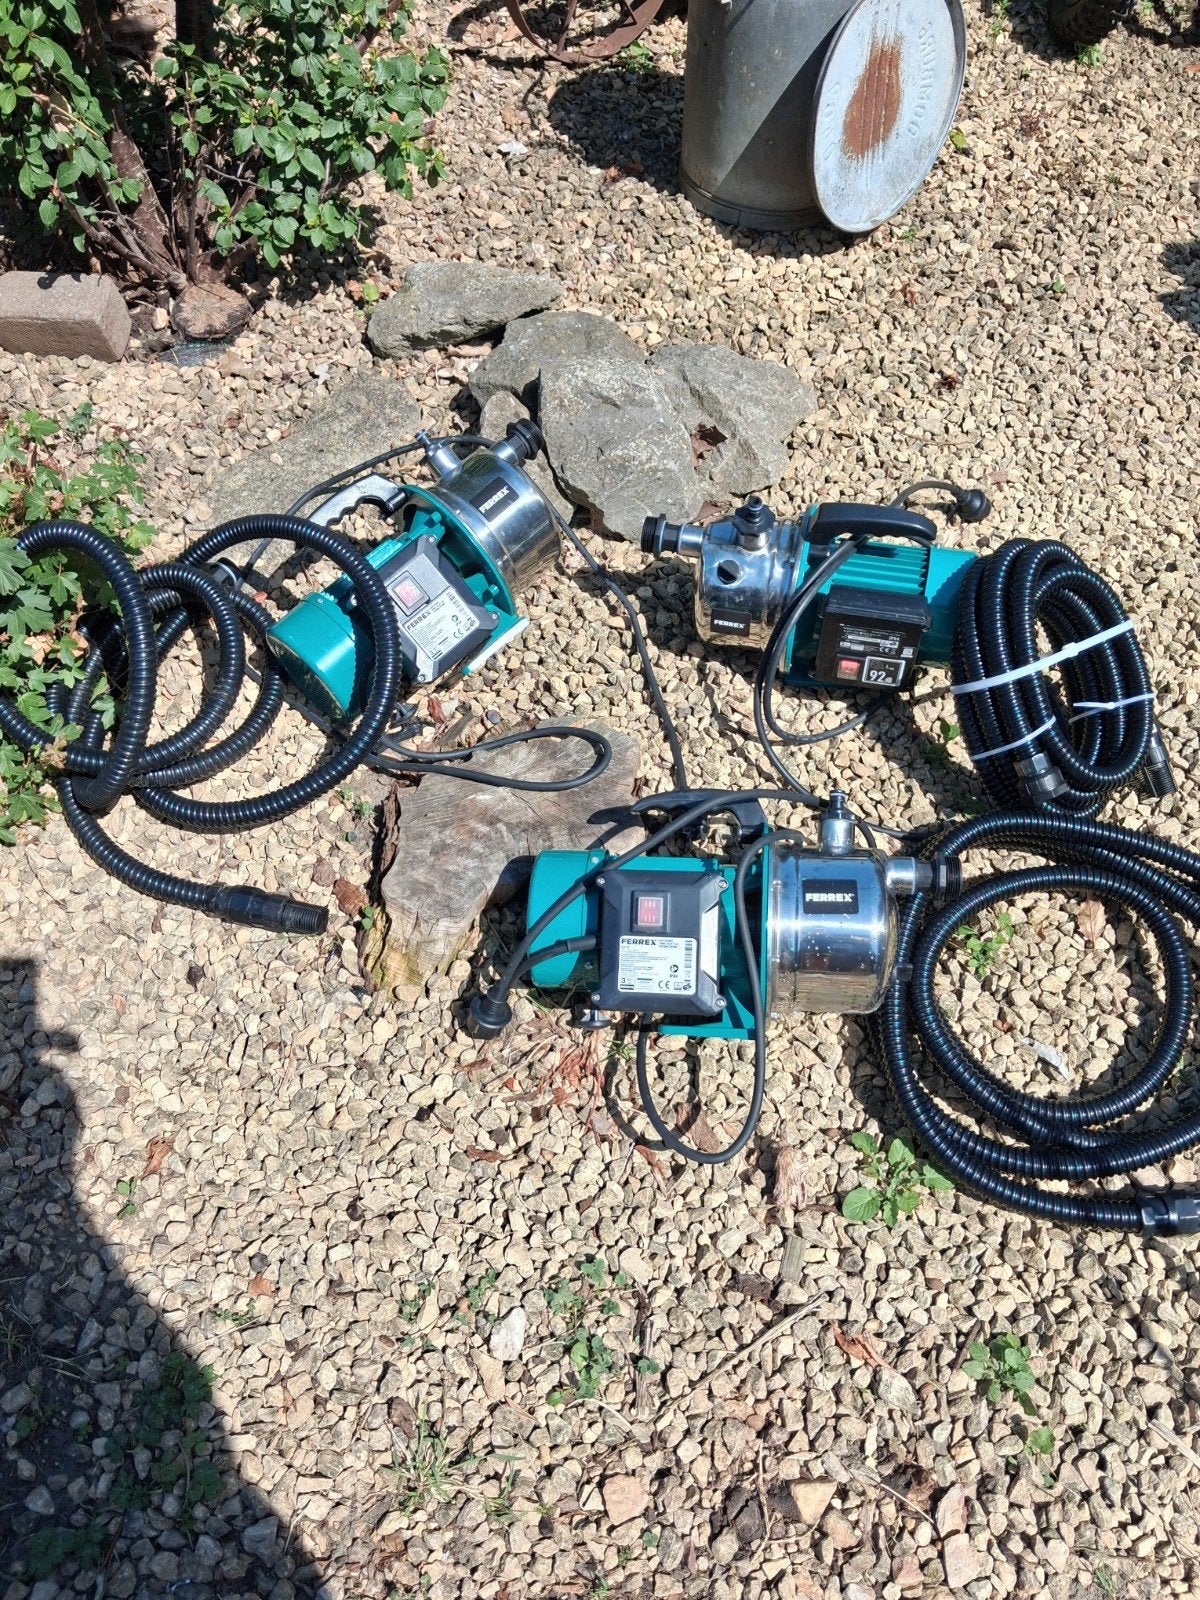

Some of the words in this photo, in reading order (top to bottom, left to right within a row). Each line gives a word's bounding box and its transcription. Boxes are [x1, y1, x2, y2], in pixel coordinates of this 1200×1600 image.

[479, 485, 510, 513] FERREX
[406, 608, 432, 631] FERREX
[713, 619, 746, 629] FERREX
[869, 670, 886, 683] 92
[805, 893, 854, 902] FERREX
[621, 938, 657, 946] FERREX
[658, 980, 671, 989] CE
